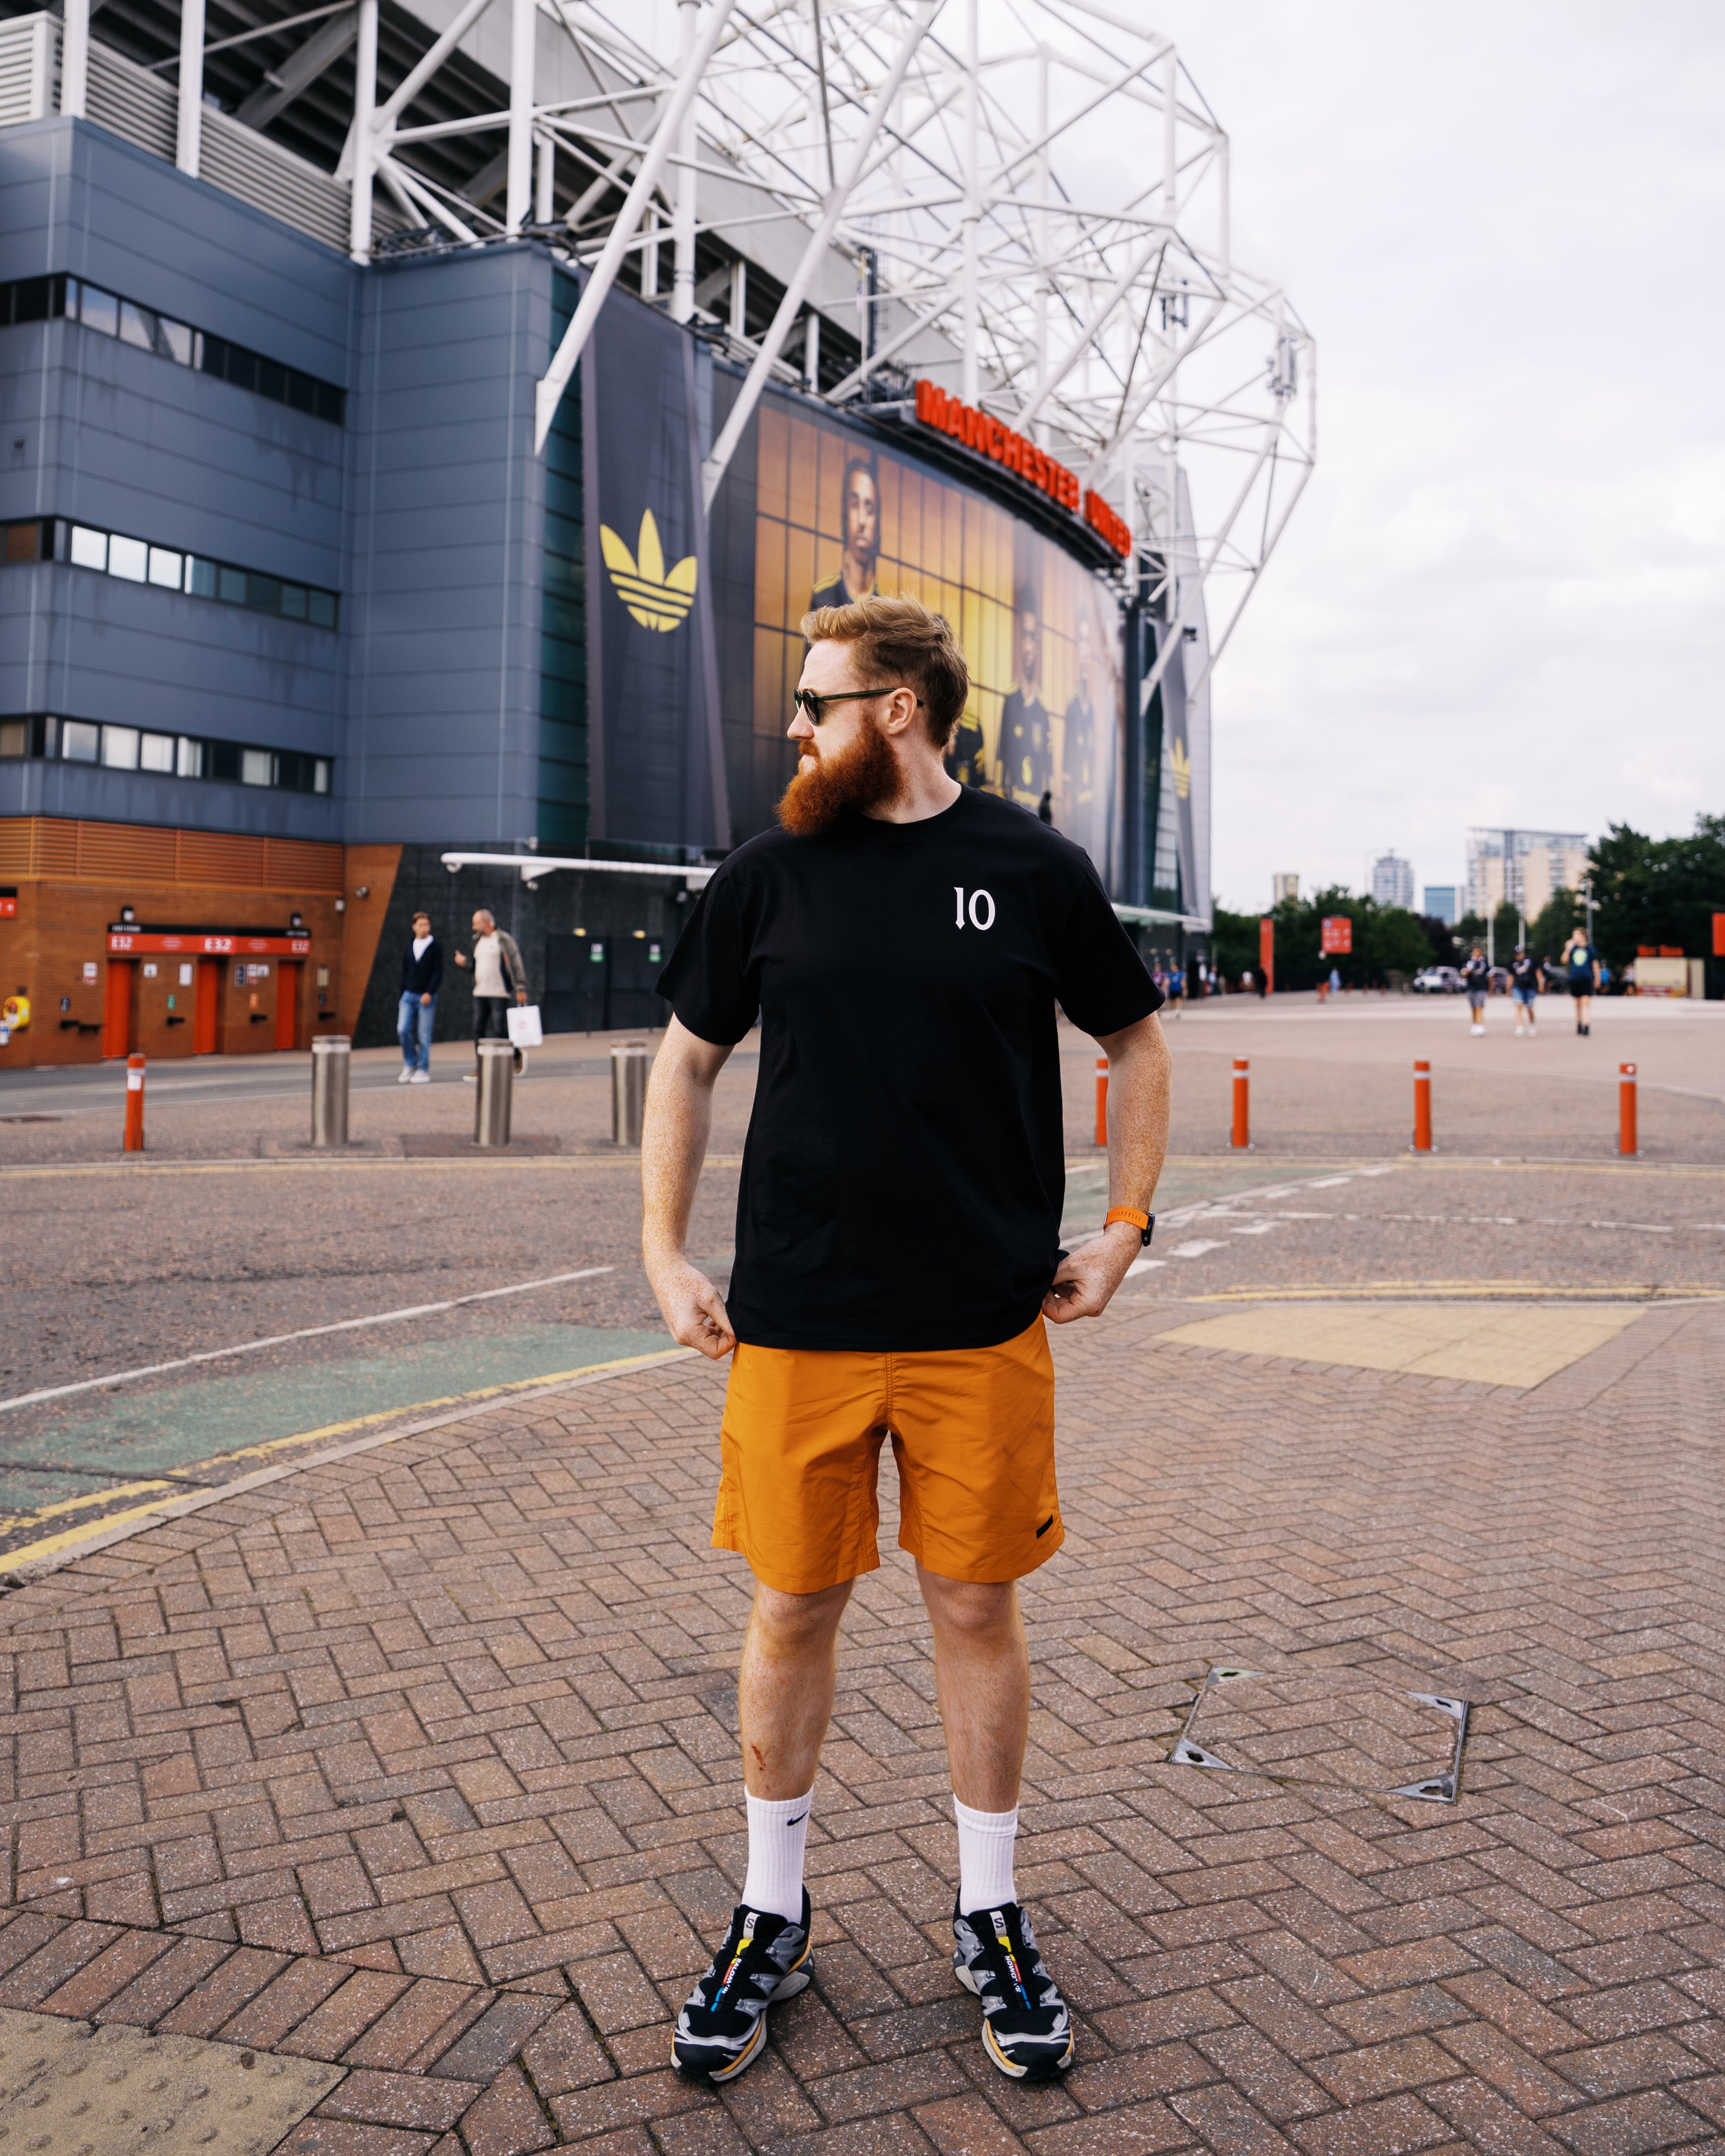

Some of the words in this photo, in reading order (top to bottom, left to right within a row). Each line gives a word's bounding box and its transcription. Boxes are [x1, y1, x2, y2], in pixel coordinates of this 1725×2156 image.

[916, 379, 1079, 514] MANCHESTER
[954, 887, 995, 930] 10
[112, 935, 133, 950] E32
[205, 938, 232, 952] E32
[292, 940, 310, 953] E32
